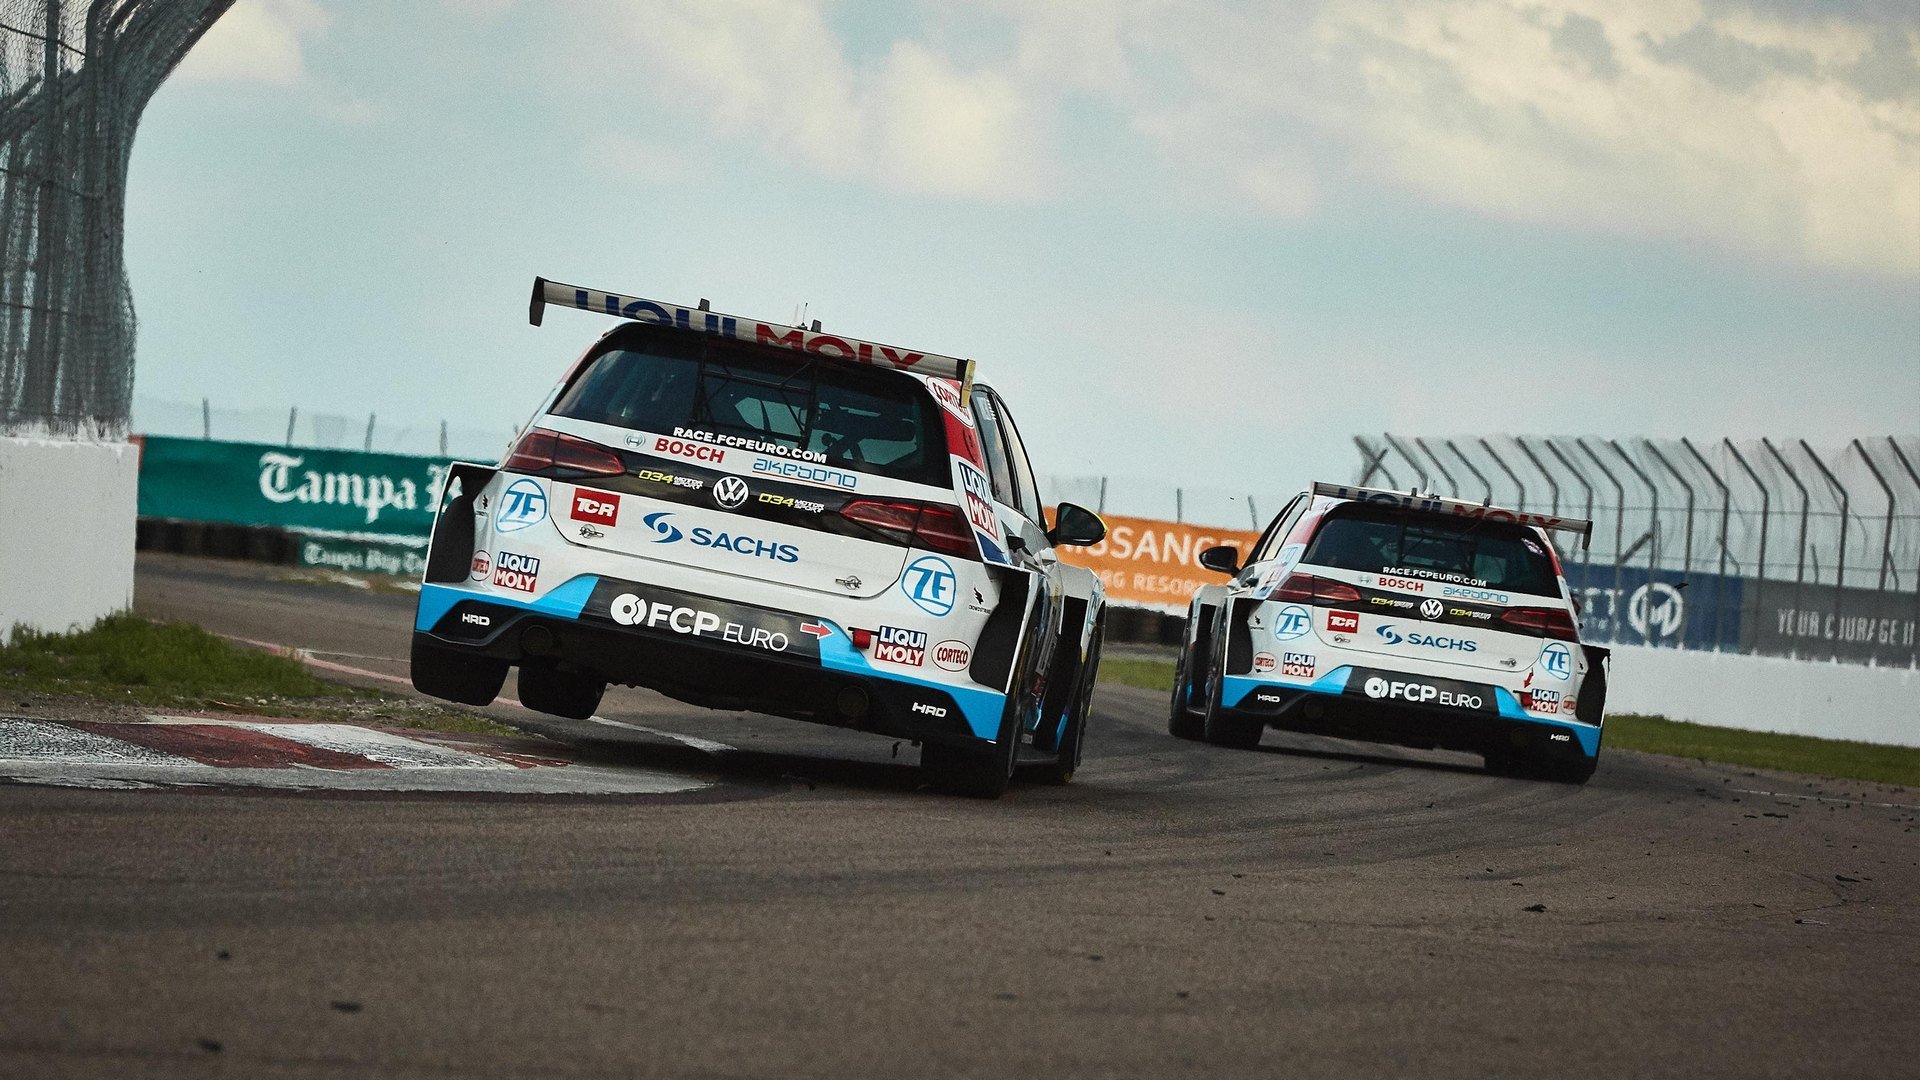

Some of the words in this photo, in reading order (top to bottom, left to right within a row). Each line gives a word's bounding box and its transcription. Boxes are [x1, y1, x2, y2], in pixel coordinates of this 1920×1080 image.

[654, 438, 725, 464] BOSCH
[673, 426, 827, 464] RACE.FCPEURO.COM
[638, 469, 673, 484] 034
[259, 452, 416, 524] Tampa
[498, 488, 546, 523] ZF
[576, 498, 616, 517] TCR
[759, 492, 794, 508] 034
[690, 527, 799, 563] SACHS
[498, 552, 539, 574] LIQUI
[494, 569, 537, 591] MOLY
[907, 564, 955, 610] ZF
[1379, 577, 1424, 592] BOSCH
[1382, 566, 1487, 588] RACE.FCPEURO.COM
[647, 602, 720, 636] FCP
[723, 622, 789, 652] EURO
[1275, 610, 1310, 636] ZF
[1330, 616, 1357, 629] TCR
[879, 626, 928, 649] LIQUI
[1407, 633, 1477, 652] SACHS
[876, 643, 925, 666] MOLY
[936, 647, 968, 666] CORTECO
[1284, 653, 1315, 667] LIQUI
[1282, 664, 1315, 678] MOLY
[1389, 681, 1437, 702] FCP
[1440, 691, 1482, 709] EURO
[1531, 688, 1559, 702] LIQUI
[1530, 700, 1558, 714] MOLY
